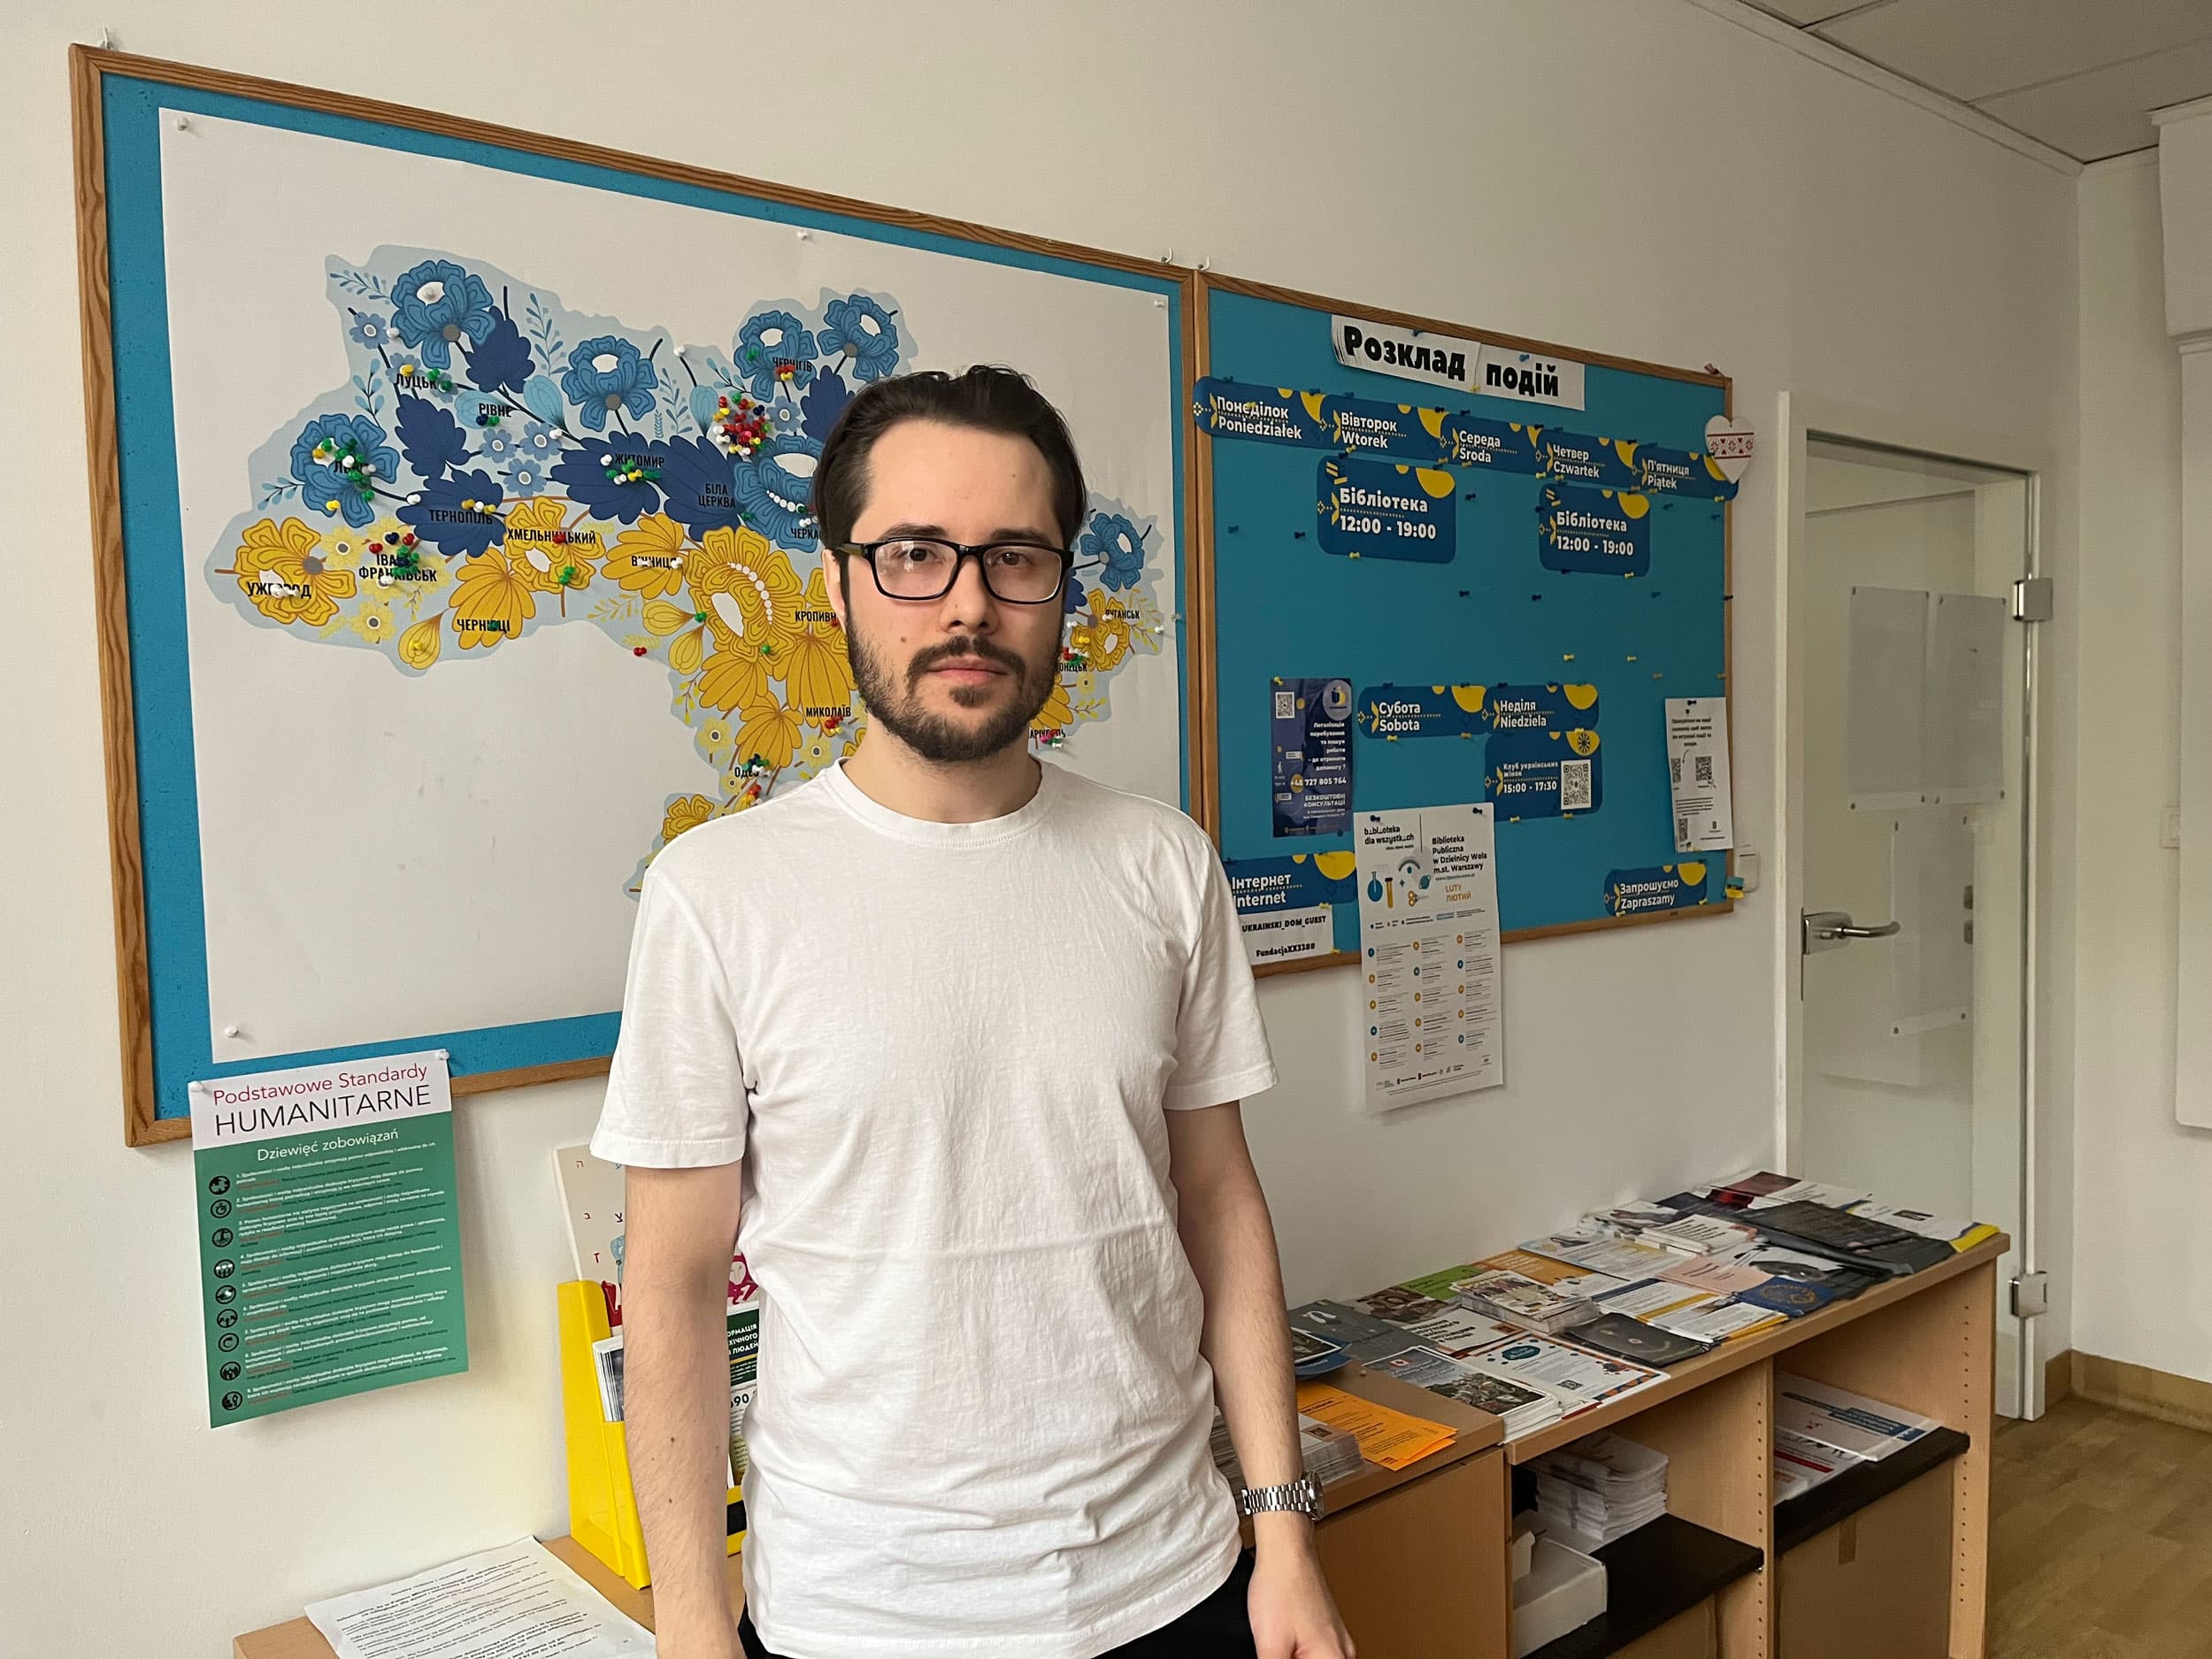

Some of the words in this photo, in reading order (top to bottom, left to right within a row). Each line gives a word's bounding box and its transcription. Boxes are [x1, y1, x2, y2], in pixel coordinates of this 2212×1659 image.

[1343, 325, 1466, 381] Розклад
[1486, 362, 1559, 397] подій
[396, 373, 437, 390] ЛУЦЬК
[479, 403, 512, 418] РІВНЕ
[1217, 396, 1289, 420] Понеділок
[1218, 417, 1302, 441] Poniedziałek
[1341, 412, 1397, 433] Вівторок
[1341, 430, 1388, 449] Wtorek
[1459, 430, 1502, 449] Середа
[615, 452, 664, 468] ЖИТОМИР
[1459, 444, 1492, 464] Środa
[1553, 444, 1589, 462] Четвер
[1553, 462, 1601, 479] Czwartek
[1647, 459, 1690, 476] П'ятниця
[705, 483, 728, 496] БІЛА
[1647, 474, 1678, 490] Piątek
[698, 495, 736, 509] ЦЕРКВА
[1340, 487, 1428, 513] Бібліотека
[429, 510, 493, 525] ТЕРНОПІЛЬ
[1556, 511, 1627, 533] Бібліотека
[1340, 515, 1382, 534] 12:00
[1397, 520, 1437, 540] 19:00
[1556, 535, 1590, 552] 12:00
[1602, 539, 1634, 556] 19:00
[795, 611, 837, 622] КРОПИВН
[806, 703, 851, 718] МИКОЛАЇВ
[1379, 701, 1421, 717] Субота
[1500, 698, 1536, 713] Неділя
[1379, 718, 1421, 733] Sobota
[1501, 714, 1547, 728] Niedziela
[1503, 782, 1527, 794] 15:00
[1534, 780, 1557, 792] 17:30
[1432, 835, 1464, 845] Biblioteka
[1432, 845, 1463, 855] Publiczna
[1440, 853, 1470, 864] Dzielnicy
[1471, 851, 1487, 860] Wola
[1232, 873, 1292, 891] Інтернет
[1620, 879, 1679, 895] Запрошуємо
[1621, 892, 1676, 910] Zapraszamy
[212, 1079, 334, 1106] Podstawowe
[339, 1063, 428, 1089] Standardy
[215, 1084, 432, 1136] HUMANITARNE
[257, 1140, 319, 1163] Dziewięć
[322, 1128, 399, 1151] zobowiązań
[731, 1394, 749, 1409] 90
